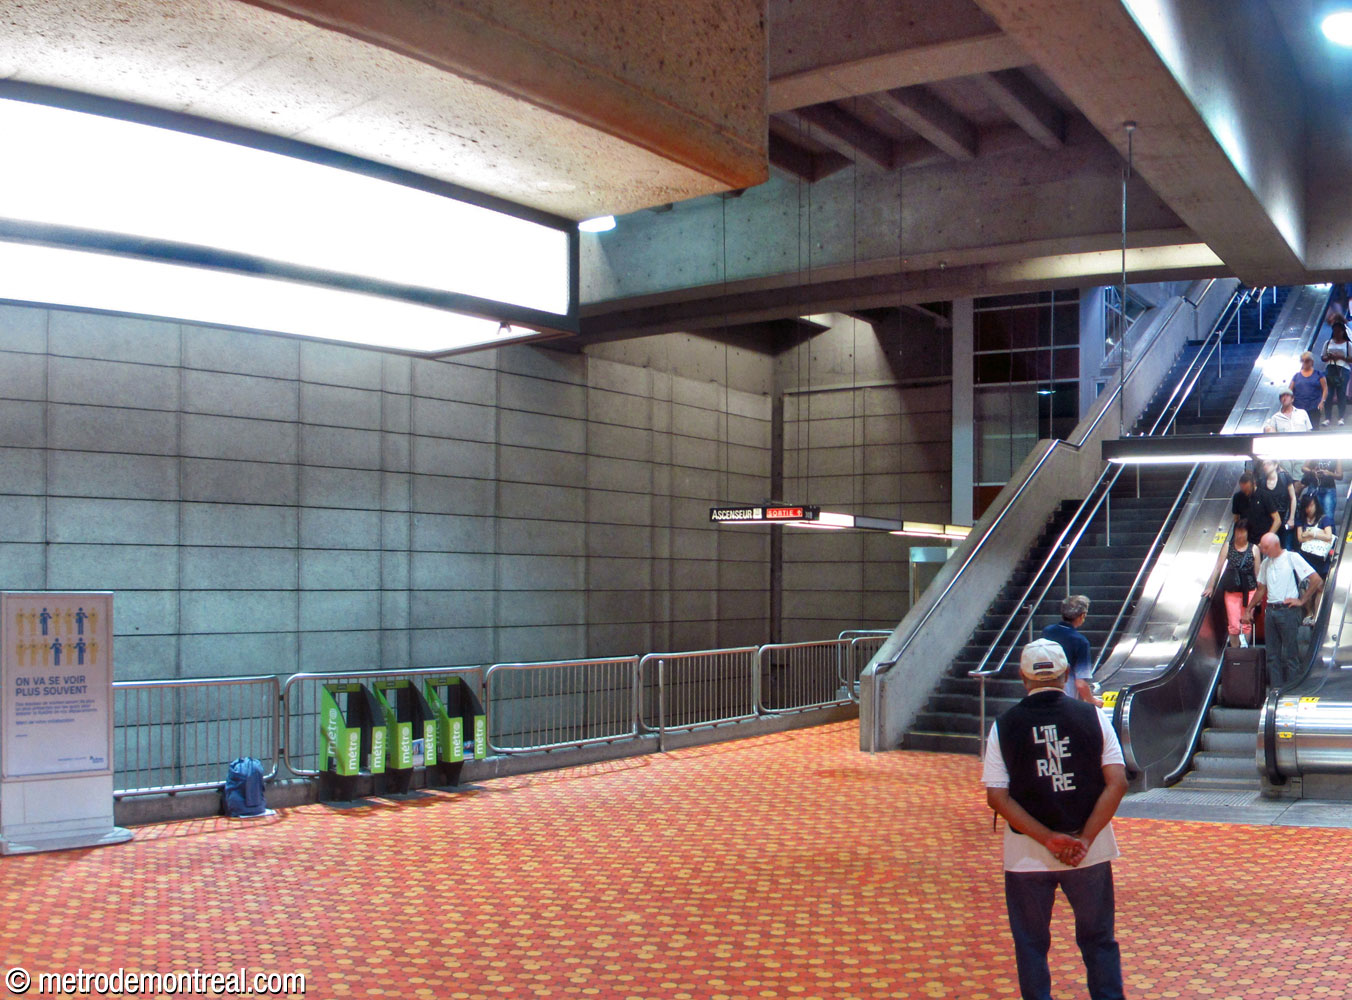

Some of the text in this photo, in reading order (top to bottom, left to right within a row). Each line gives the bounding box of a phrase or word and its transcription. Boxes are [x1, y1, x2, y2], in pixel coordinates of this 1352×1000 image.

[711, 510, 753, 520] ASCENSEUR
[15, 675, 86, 686] ON VA SE VOIR
[15, 685, 88, 696] PLUS SOUVENT
